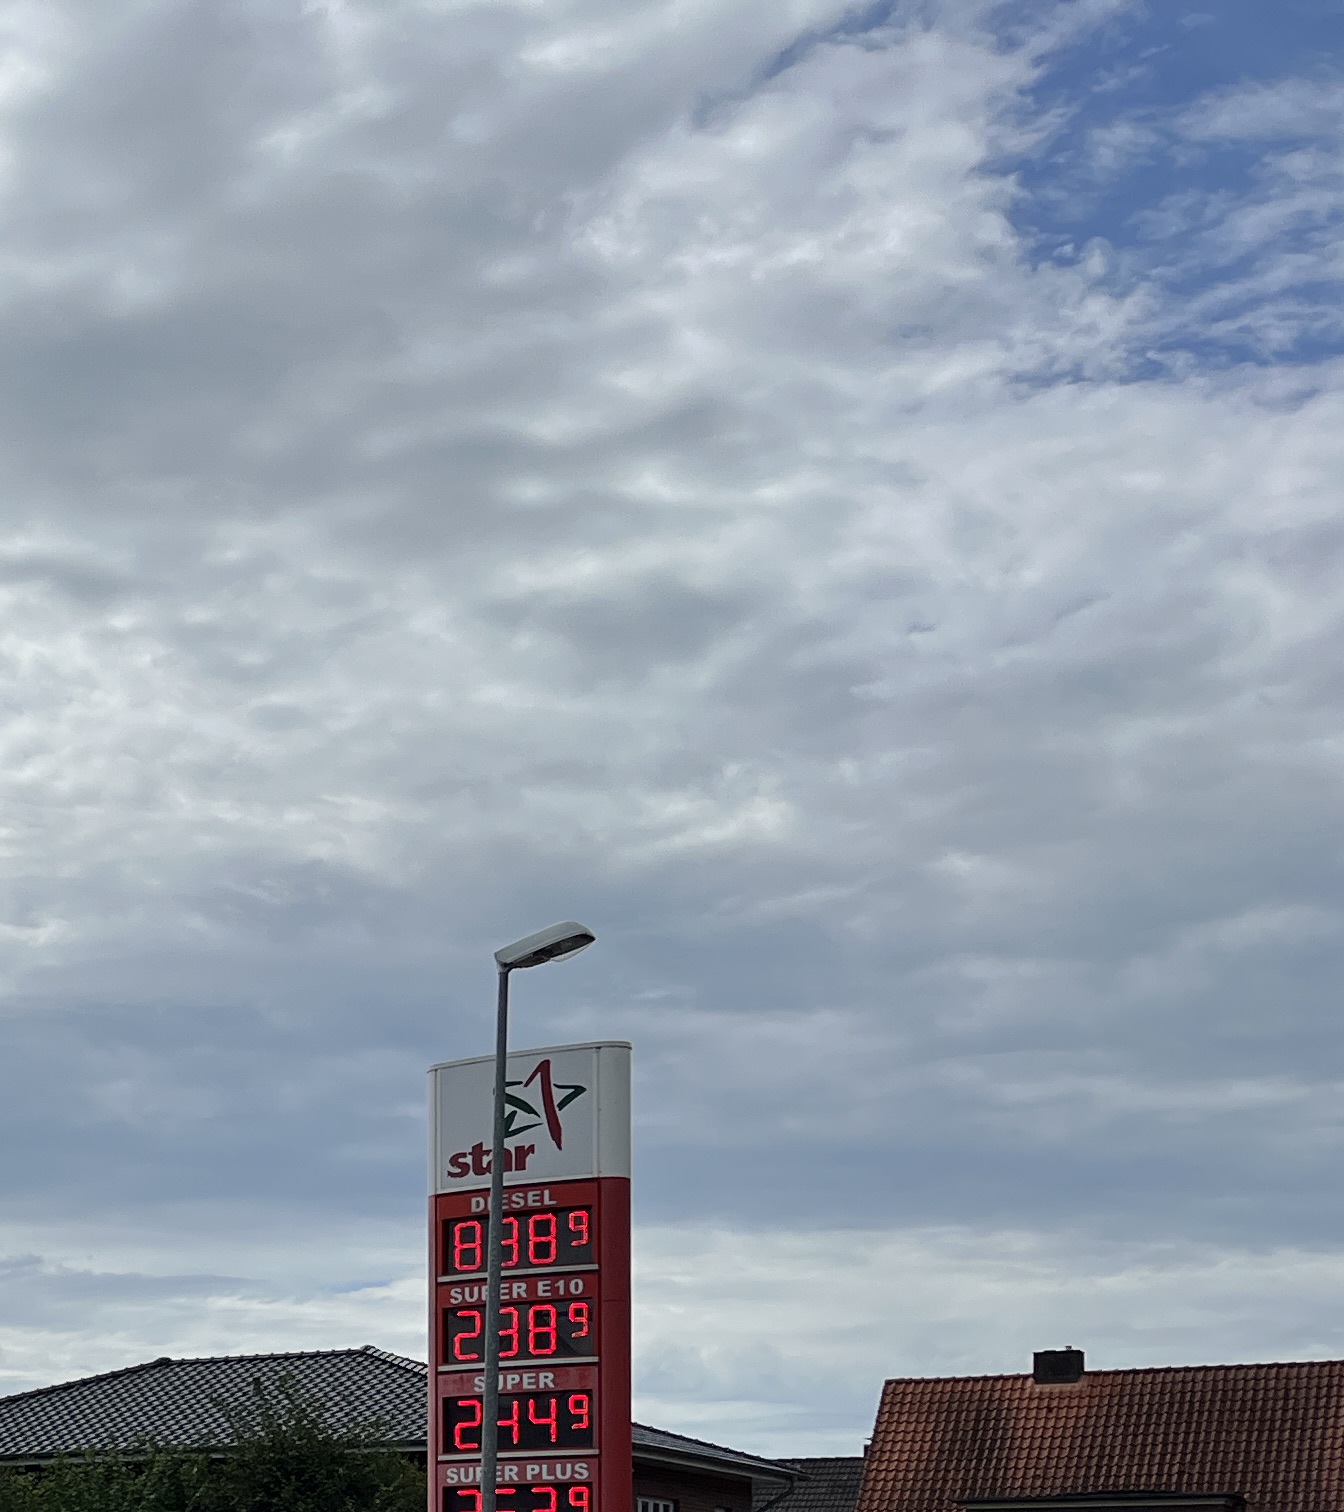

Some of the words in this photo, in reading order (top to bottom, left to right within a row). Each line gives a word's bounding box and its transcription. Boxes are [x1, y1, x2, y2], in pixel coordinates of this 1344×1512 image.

[446, 1141, 535, 1179] star
[470, 1189, 557, 1213] DESEL
[537, 1278, 584, 1297] E10
[526, 1462, 589, 1480] PLUS
